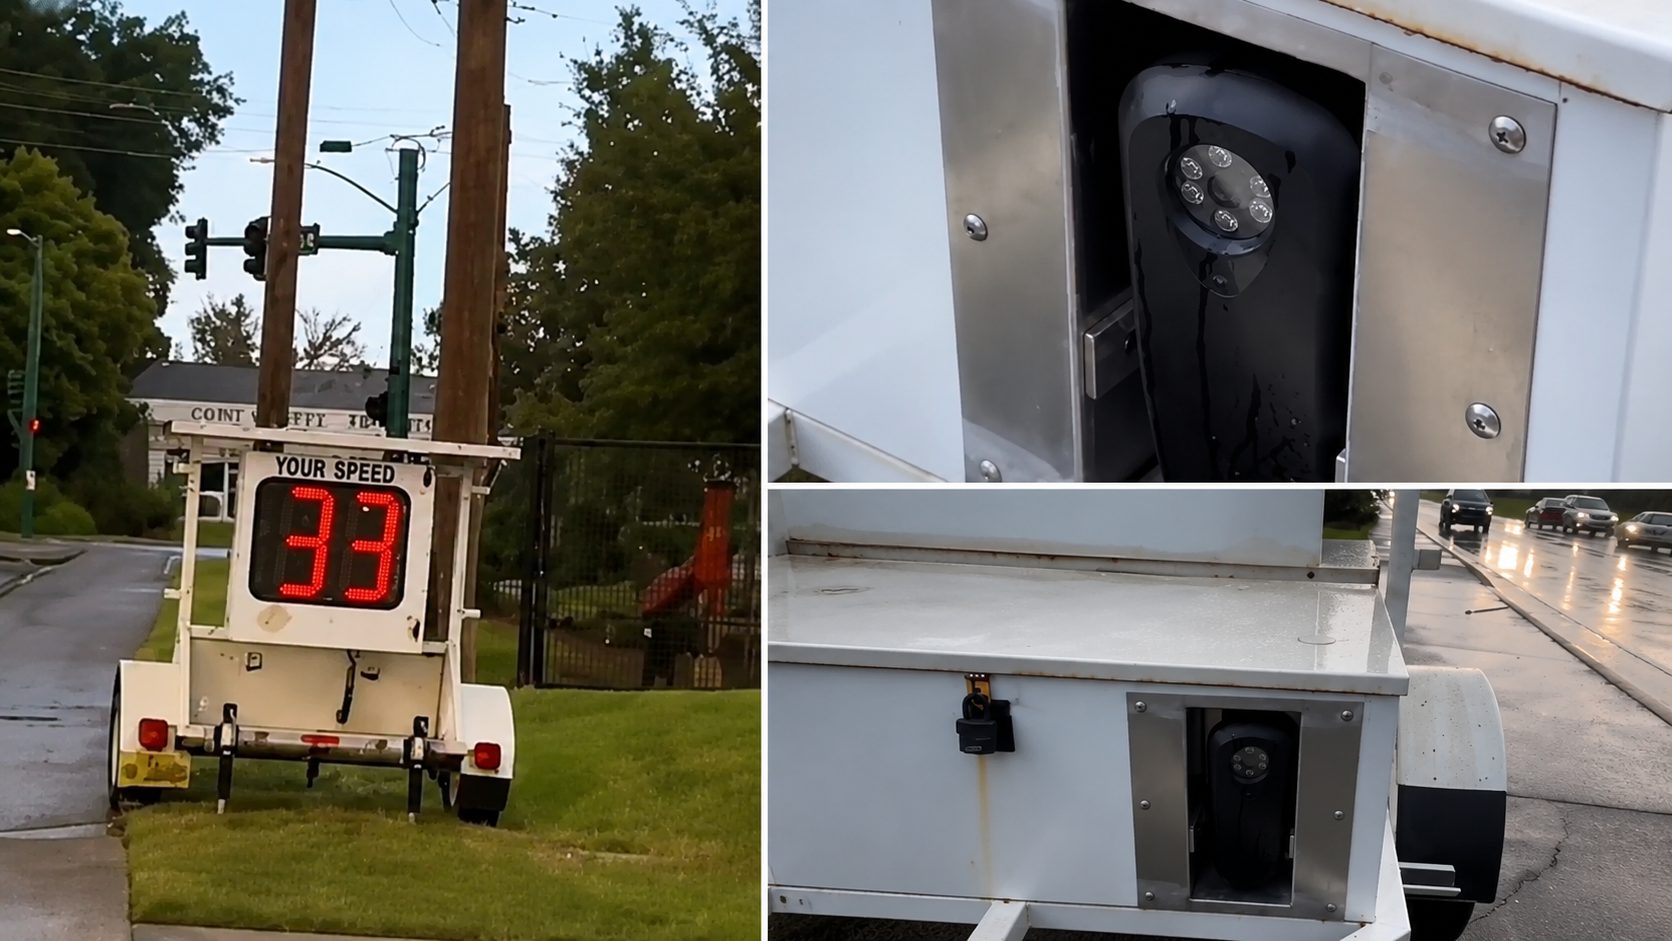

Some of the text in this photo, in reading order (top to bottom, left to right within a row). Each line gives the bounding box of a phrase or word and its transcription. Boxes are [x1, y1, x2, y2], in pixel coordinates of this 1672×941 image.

[275, 456, 396, 484] YOUR SPEED
[280, 486, 400, 601] 33
